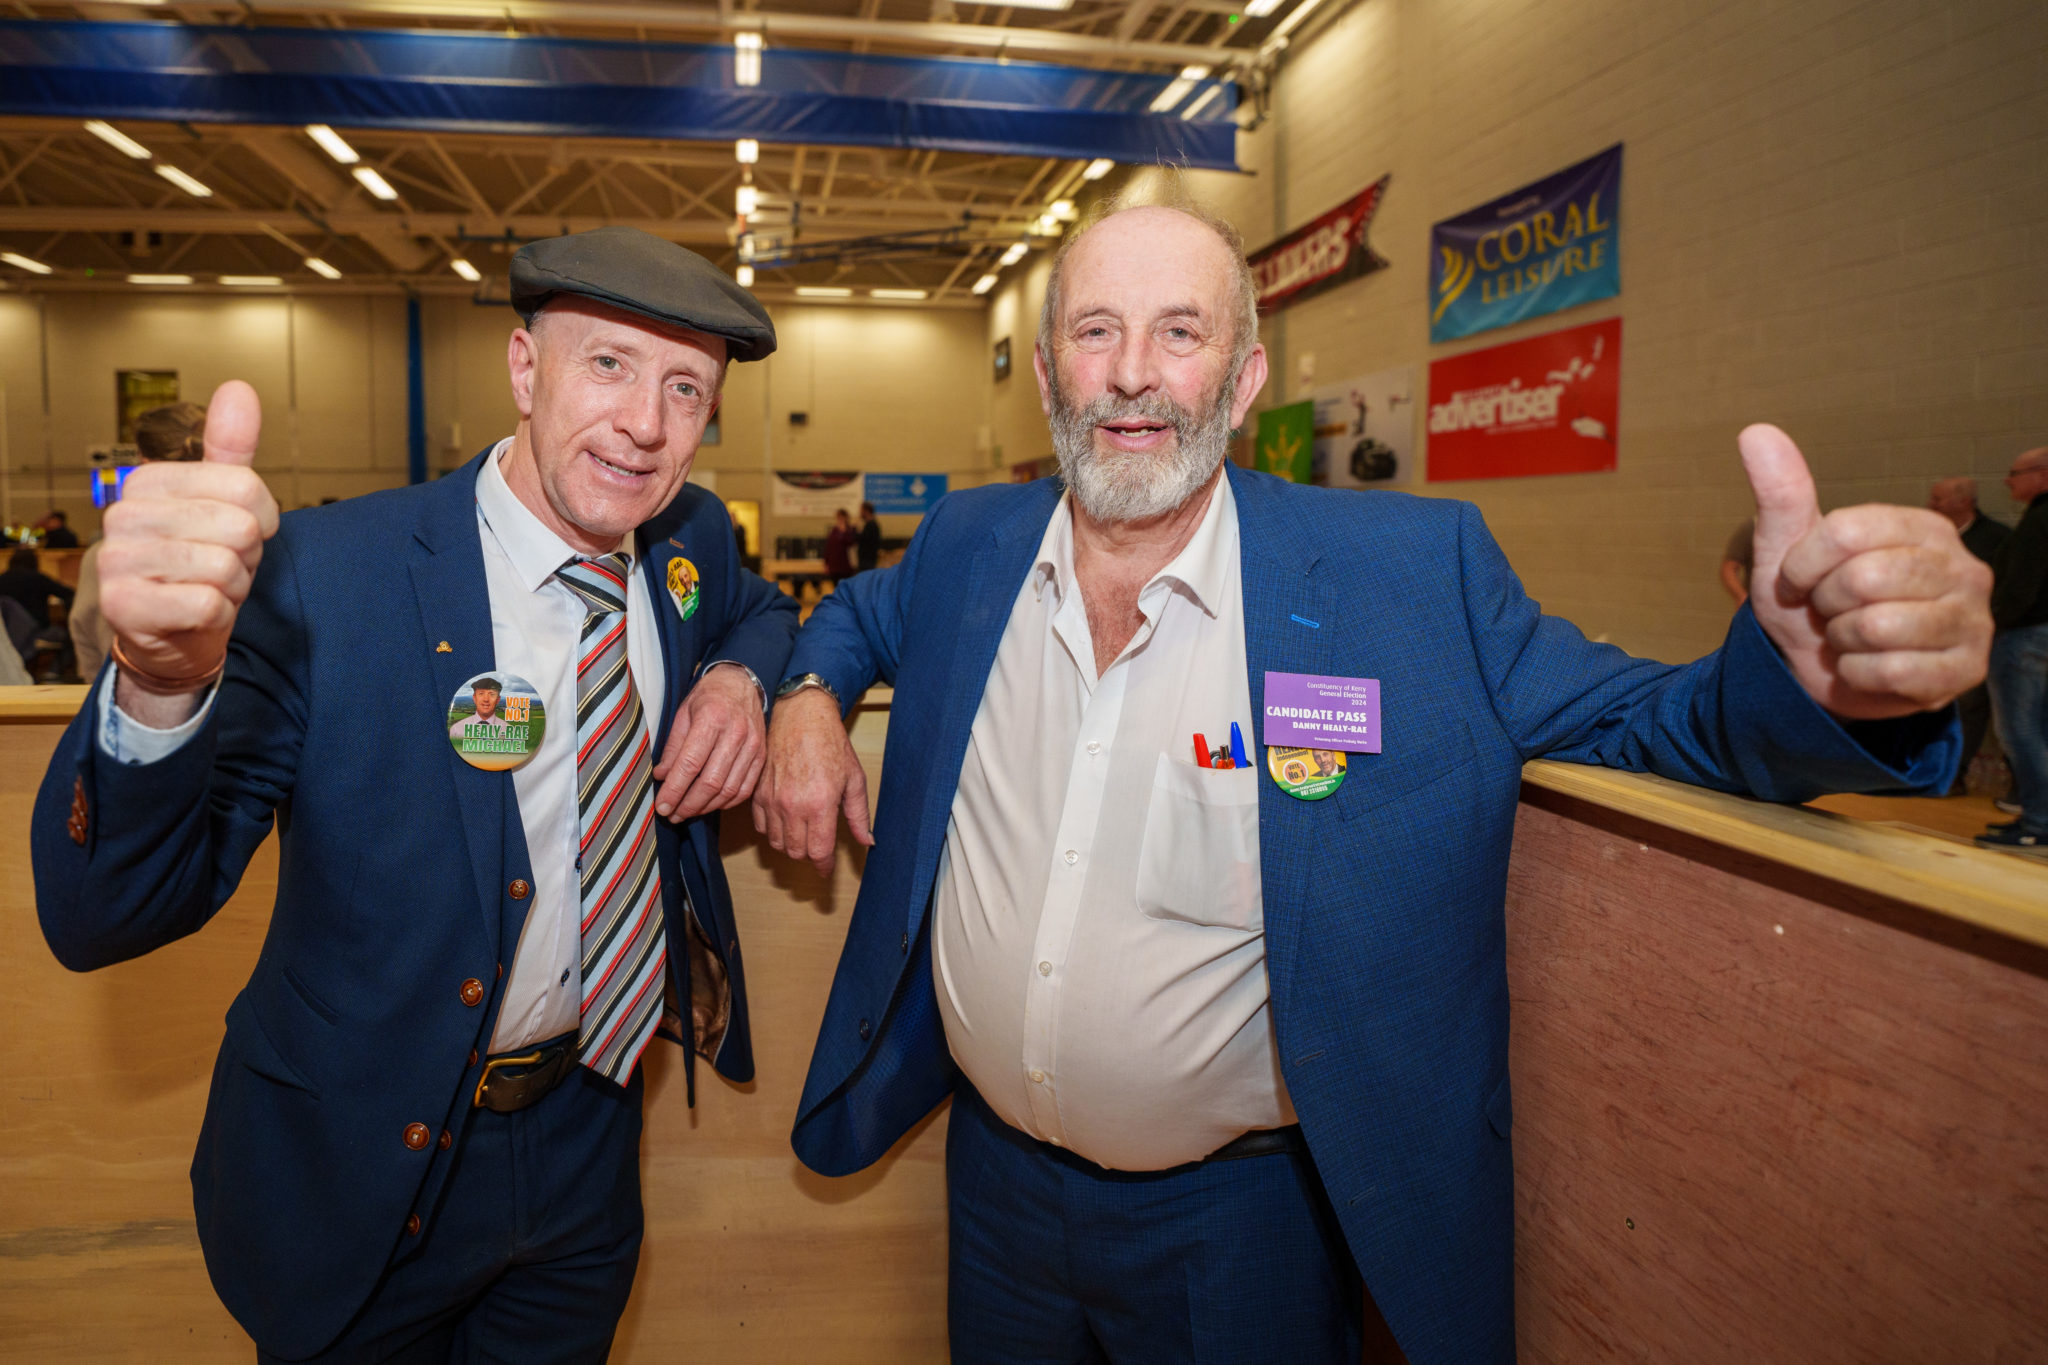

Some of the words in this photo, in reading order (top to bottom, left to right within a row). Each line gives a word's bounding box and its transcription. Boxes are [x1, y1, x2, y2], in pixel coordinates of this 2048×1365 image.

[1475, 192, 1610, 271] CORAL
[1481, 237, 1608, 304] LEISURE
[1430, 378, 1564, 433] advertiser
[1306, 681, 1342, 693] Constituency
[1319, 689, 1342, 697] General
[1343, 691, 1367, 699] Election
[506, 696, 531, 708] VOTE
[504, 708, 529, 722] NO.1
[1266, 706, 1333, 720] CANDIDATE
[1336, 711, 1367, 723] PASS
[463, 724, 529, 740] HEALY-RAE
[1292, 721, 1321, 731] DANNY
[1322, 723, 1367, 733] HEALY-RAE
[462, 738, 529, 754] MICHAEL
